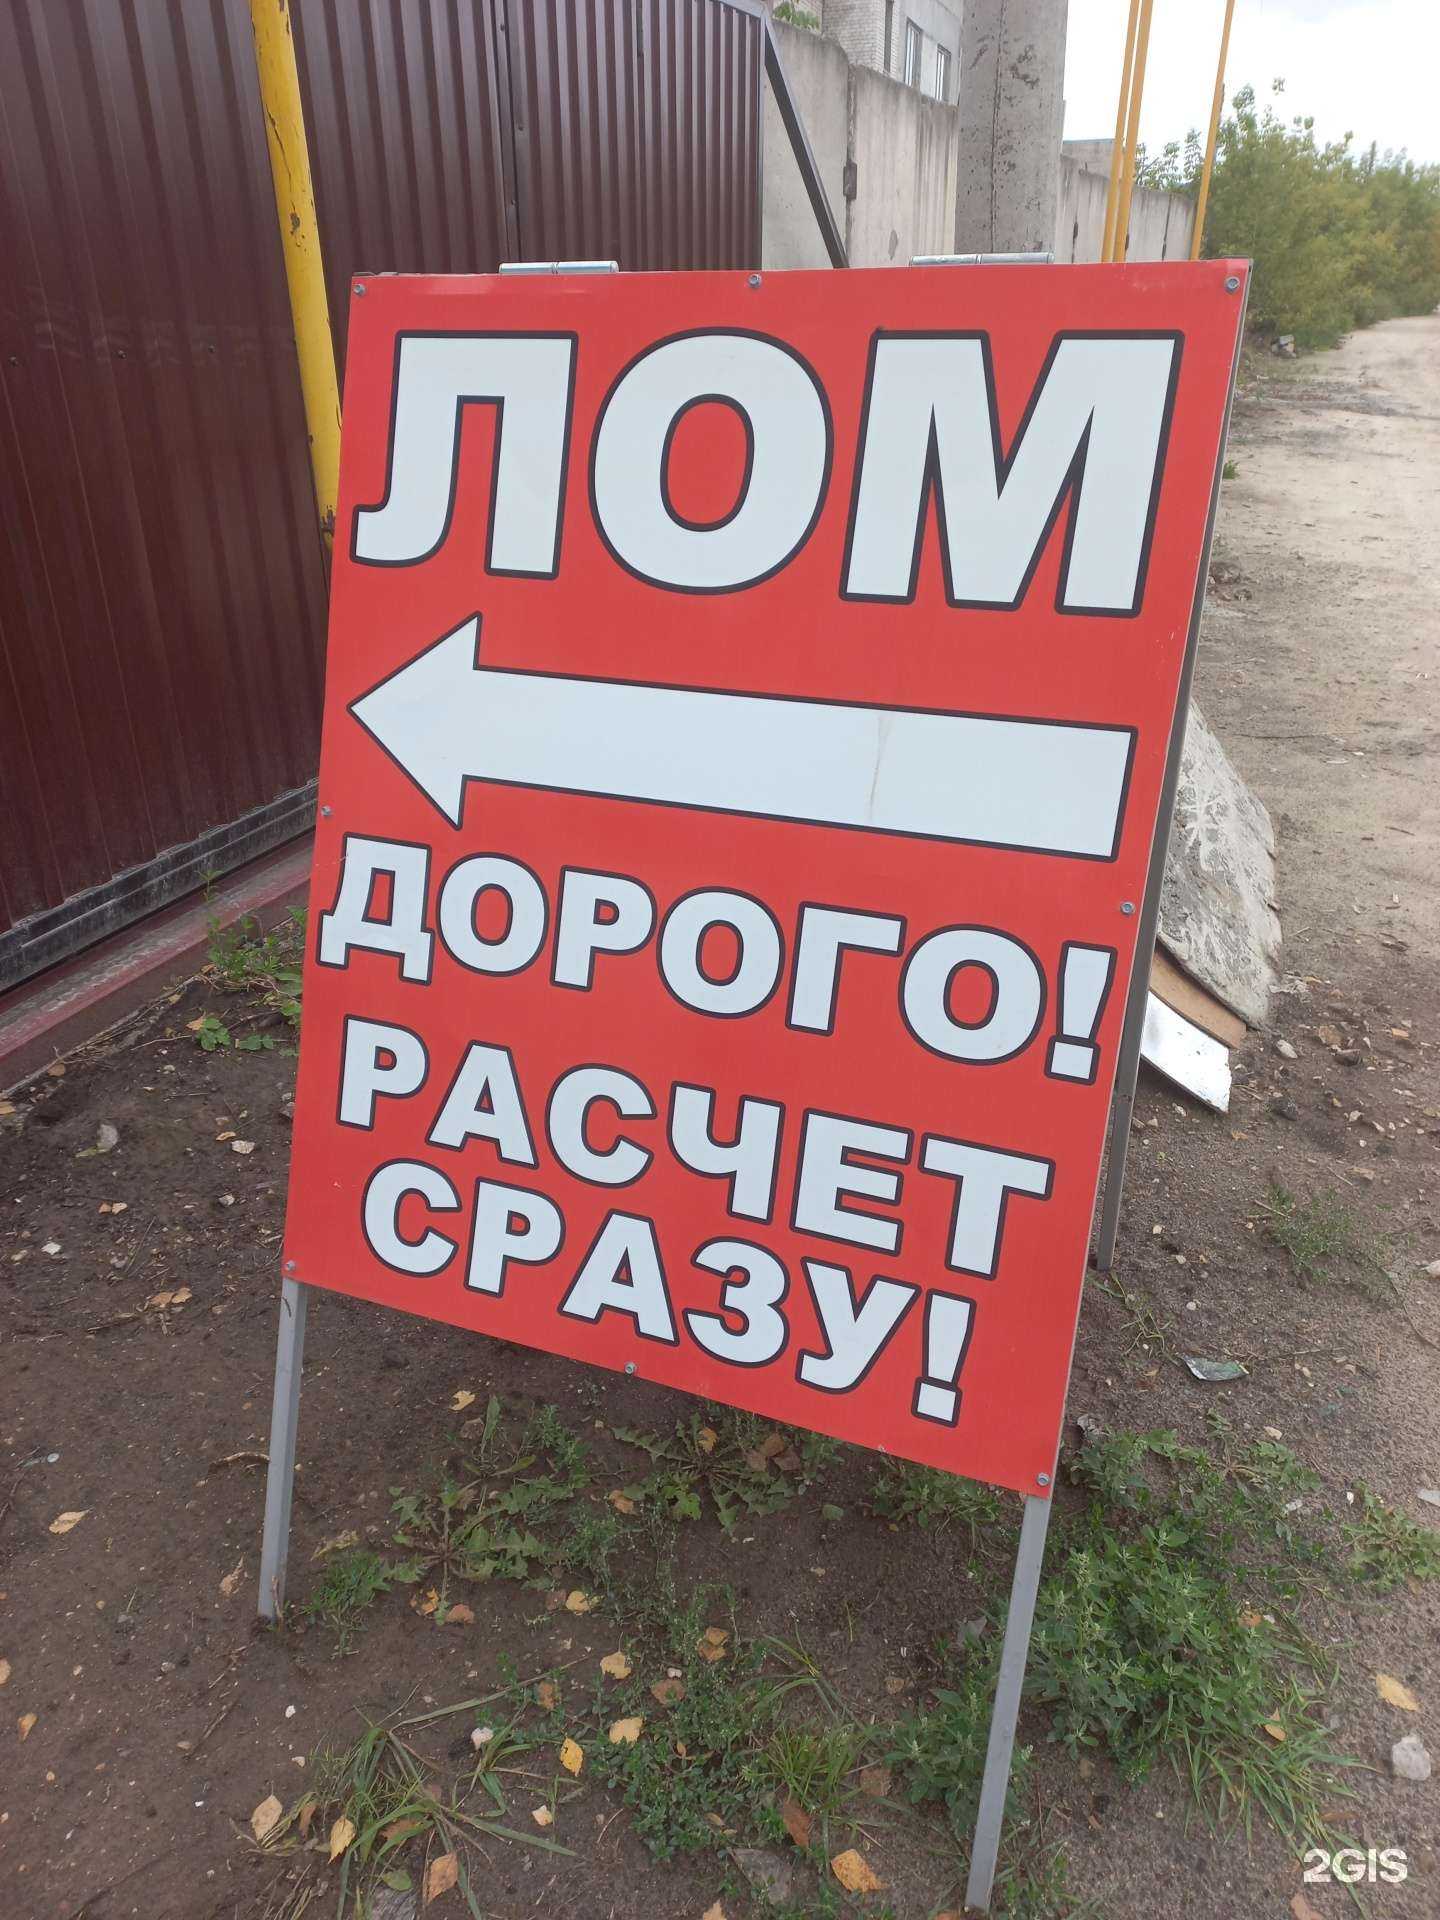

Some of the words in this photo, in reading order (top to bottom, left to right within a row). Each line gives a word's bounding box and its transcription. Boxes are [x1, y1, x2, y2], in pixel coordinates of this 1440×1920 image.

[352, 330, 1183, 617] ЛОМ
[317, 834, 1116, 1084] ДОРОГО!
[337, 1015, 1054, 1280] РАСЧЕТ
[361, 1159, 975, 1425] СРАЗУ!
